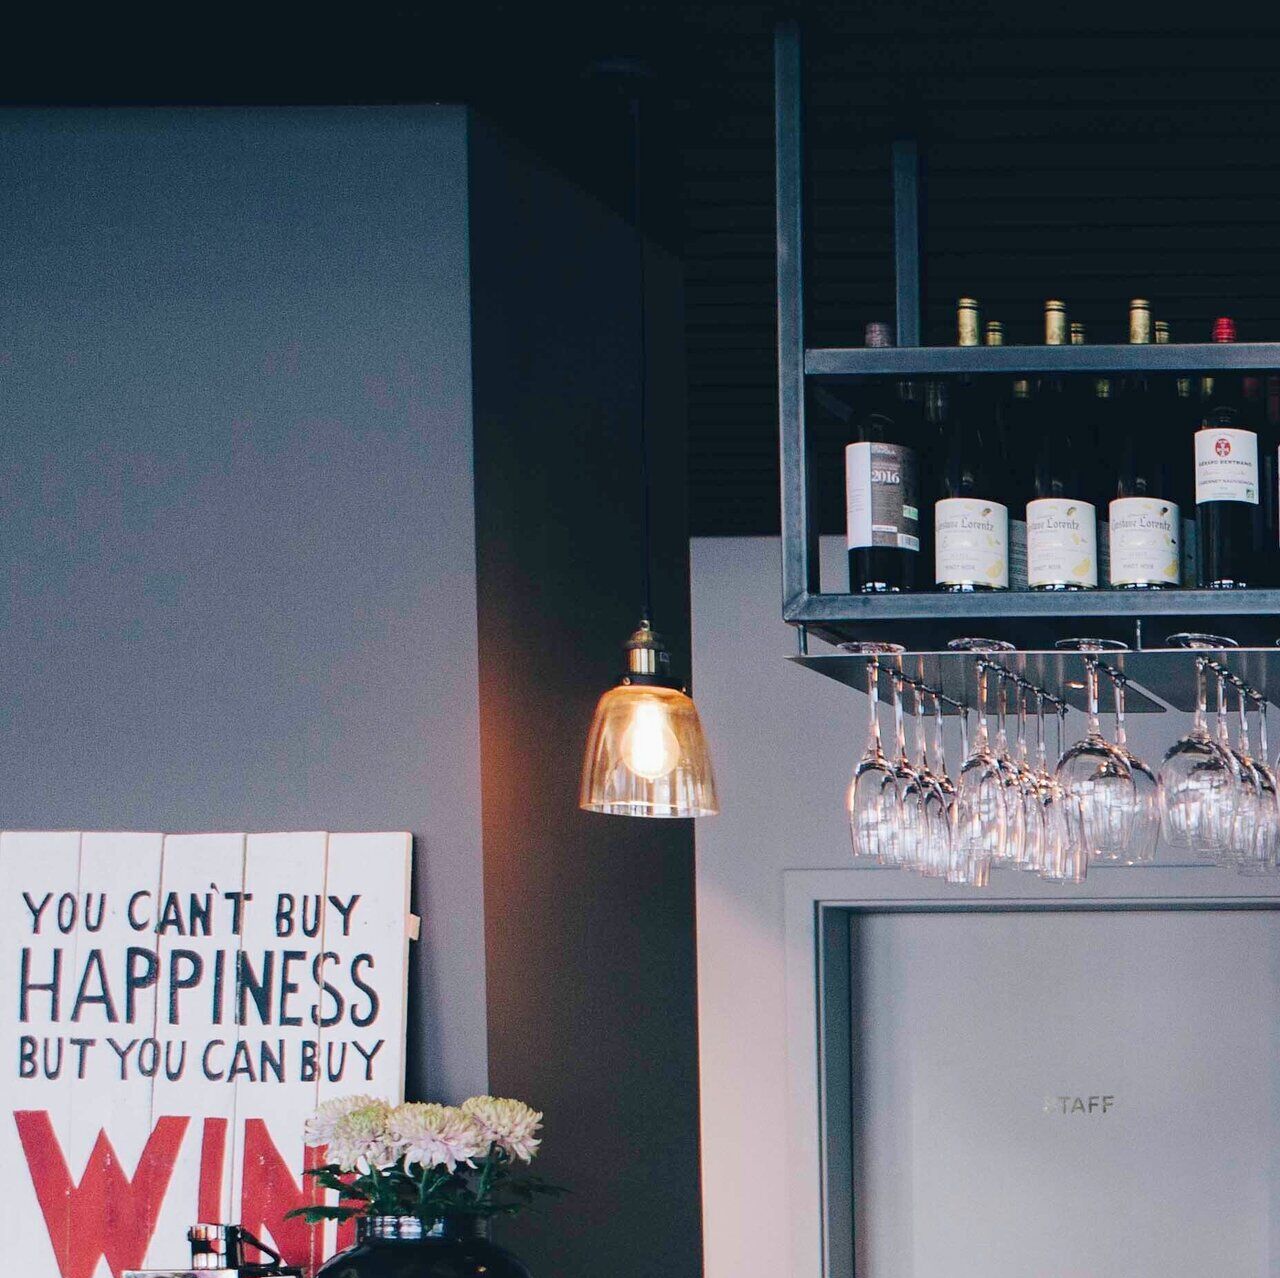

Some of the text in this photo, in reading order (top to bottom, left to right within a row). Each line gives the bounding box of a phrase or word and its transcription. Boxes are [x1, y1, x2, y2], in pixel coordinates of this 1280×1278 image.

[871, 470, 900, 484] 2016
[959, 516, 995, 532] Lorentz
[1138, 516, 1172, 532] Lorentz
[22, 882, 363, 938] YOU CAN'T BUY
[19, 946, 381, 1028] HAPPINESS
[19, 1034, 386, 1084] BUT YOU CAN BUY
